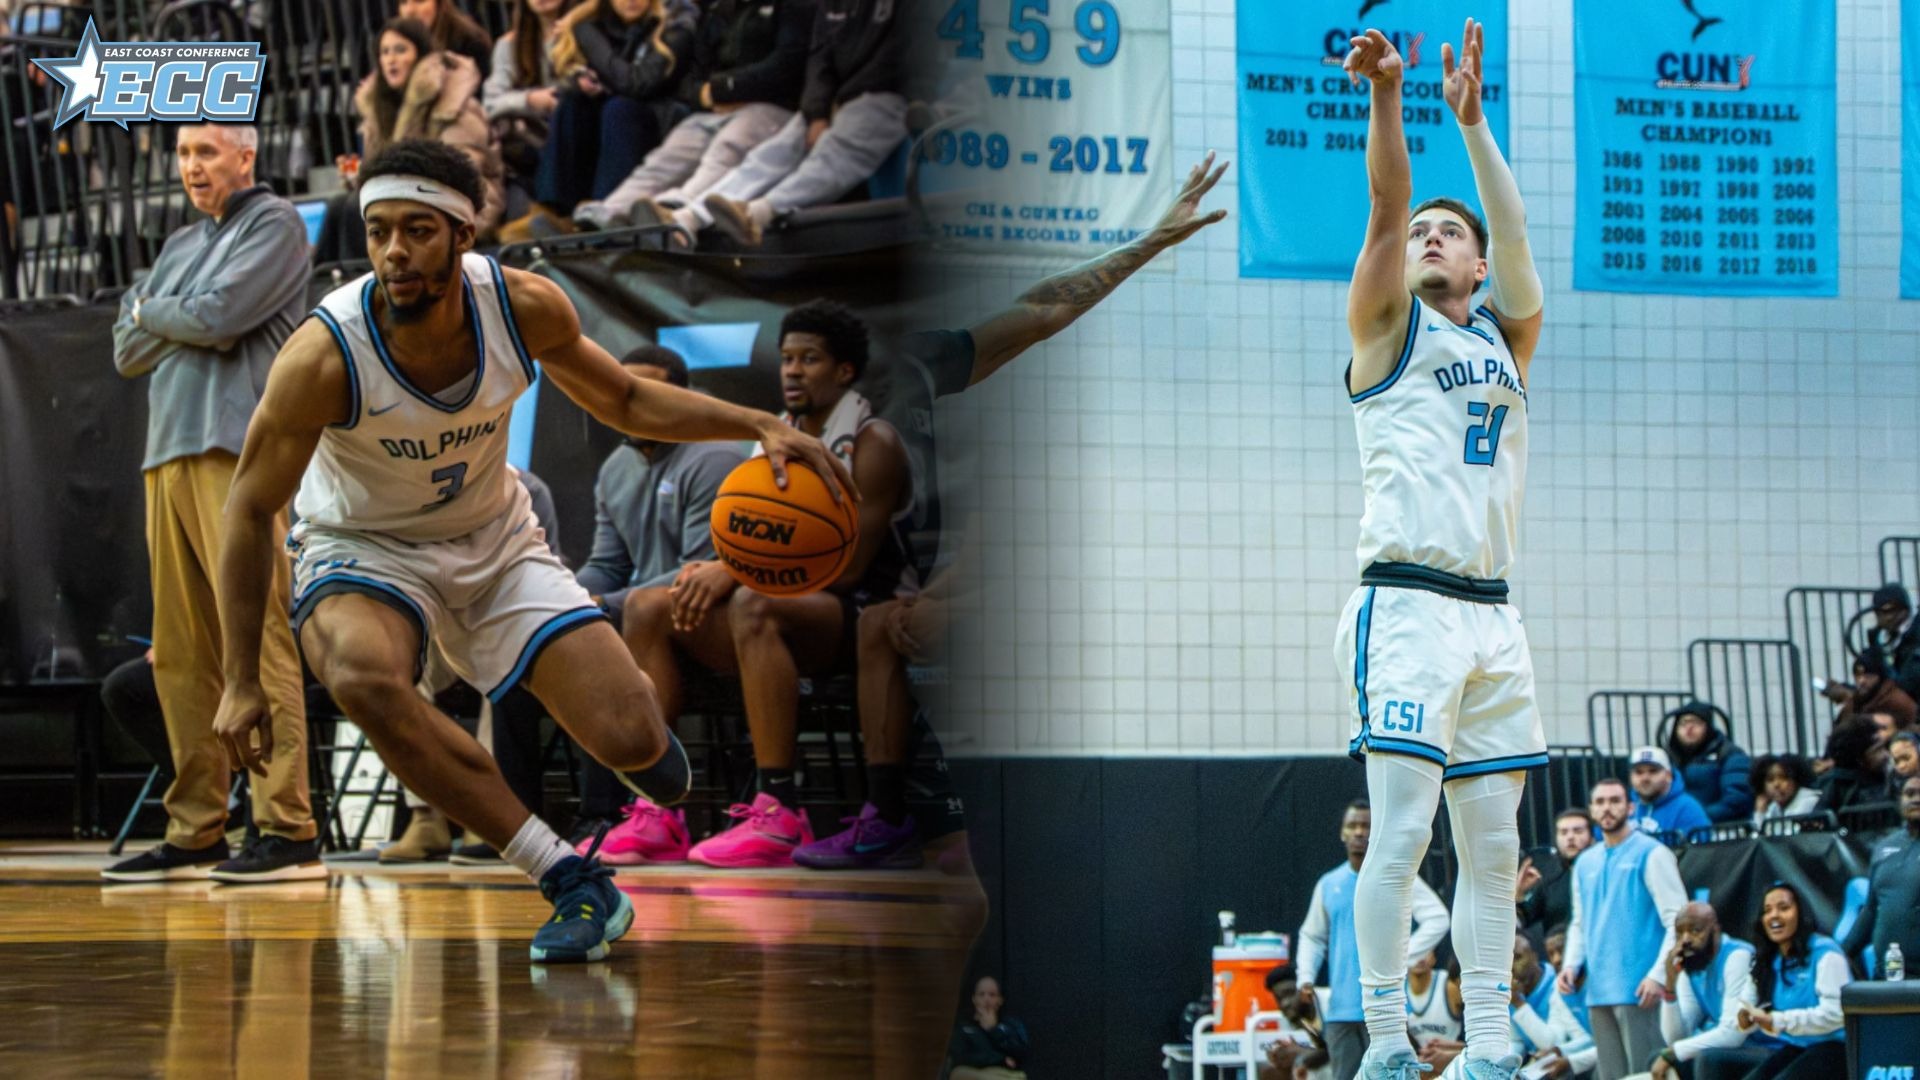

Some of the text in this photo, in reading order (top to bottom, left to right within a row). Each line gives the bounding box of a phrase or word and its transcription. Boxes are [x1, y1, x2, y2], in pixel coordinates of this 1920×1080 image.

[1324, 28, 1425, 64] CY
[984, 74, 1072, 100] WINS
[1246, 73, 1315, 95] MEN'S
[1322, 76, 1371, 98] CRO
[1306, 101, 1443, 125] CHAMONS
[1615, 97, 1800, 122] MEN'S BASEBALL
[1265, 128, 1308, 149] 2013
[1641, 123, 1773, 146] CHAMPIONS
[1049, 136, 1149, 174] 2017
[942, 223, 994, 241] TIME
[1002, 226, 1081, 243] RECORD
[1089, 228, 1143, 244] HOLD
[1716, 232, 1760, 250] 2011
[1602, 252, 1645, 271] 2015
[1659, 254, 1702, 273] 2016
[1773, 257, 1815, 275] 2018
[1463, 401, 1509, 467] 21
[422, 462, 468, 510] 3
[728, 511, 797, 545] NCAA
[1383, 700, 1425, 733] CSI
